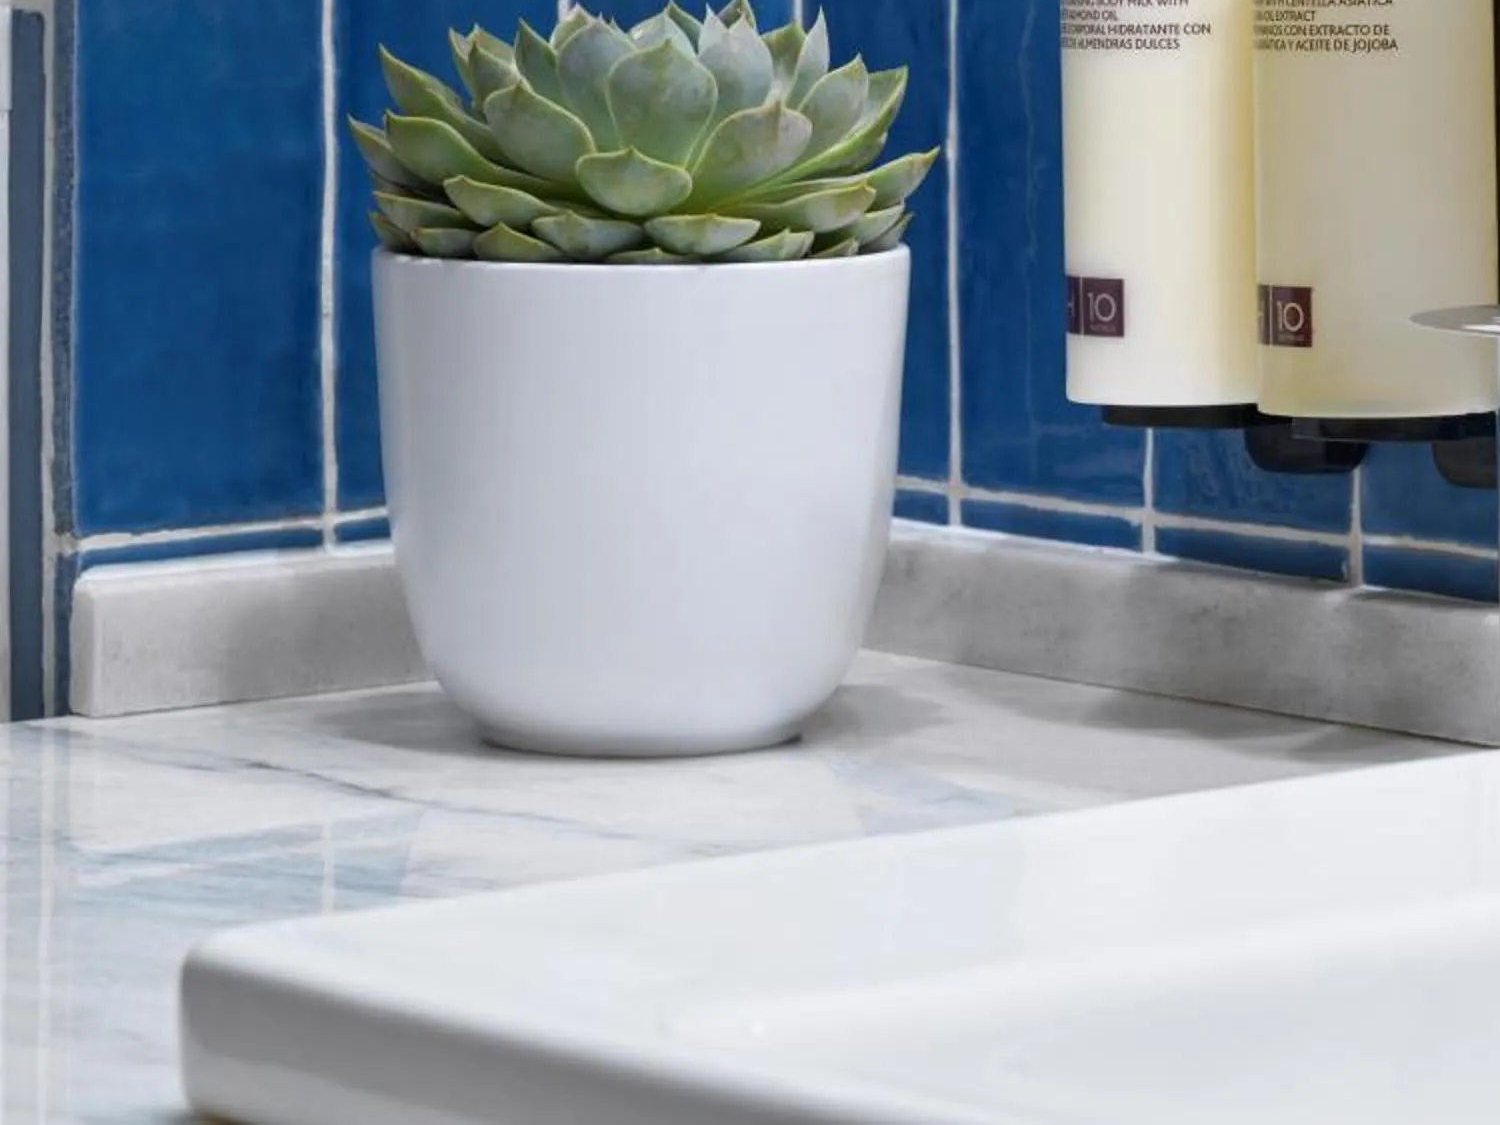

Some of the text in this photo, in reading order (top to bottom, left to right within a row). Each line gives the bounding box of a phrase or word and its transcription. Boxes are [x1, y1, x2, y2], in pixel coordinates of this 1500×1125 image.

[1107, 24, 1181, 36] HIDRATANTE
[1183, 24, 1212, 35] CON
[1309, 24, 1371, 36] EXTRACTO
[1373, 24, 1390, 36] DE
[1135, 38, 1180, 50] DULCES
[1296, 39, 1332, 52] ACEITE
[1334, 39, 1350, 52] DE
[1352, 38, 1398, 54] JOJOBA
[1087, 291, 1117, 324] 10
[1276, 300, 1305, 332] 10
